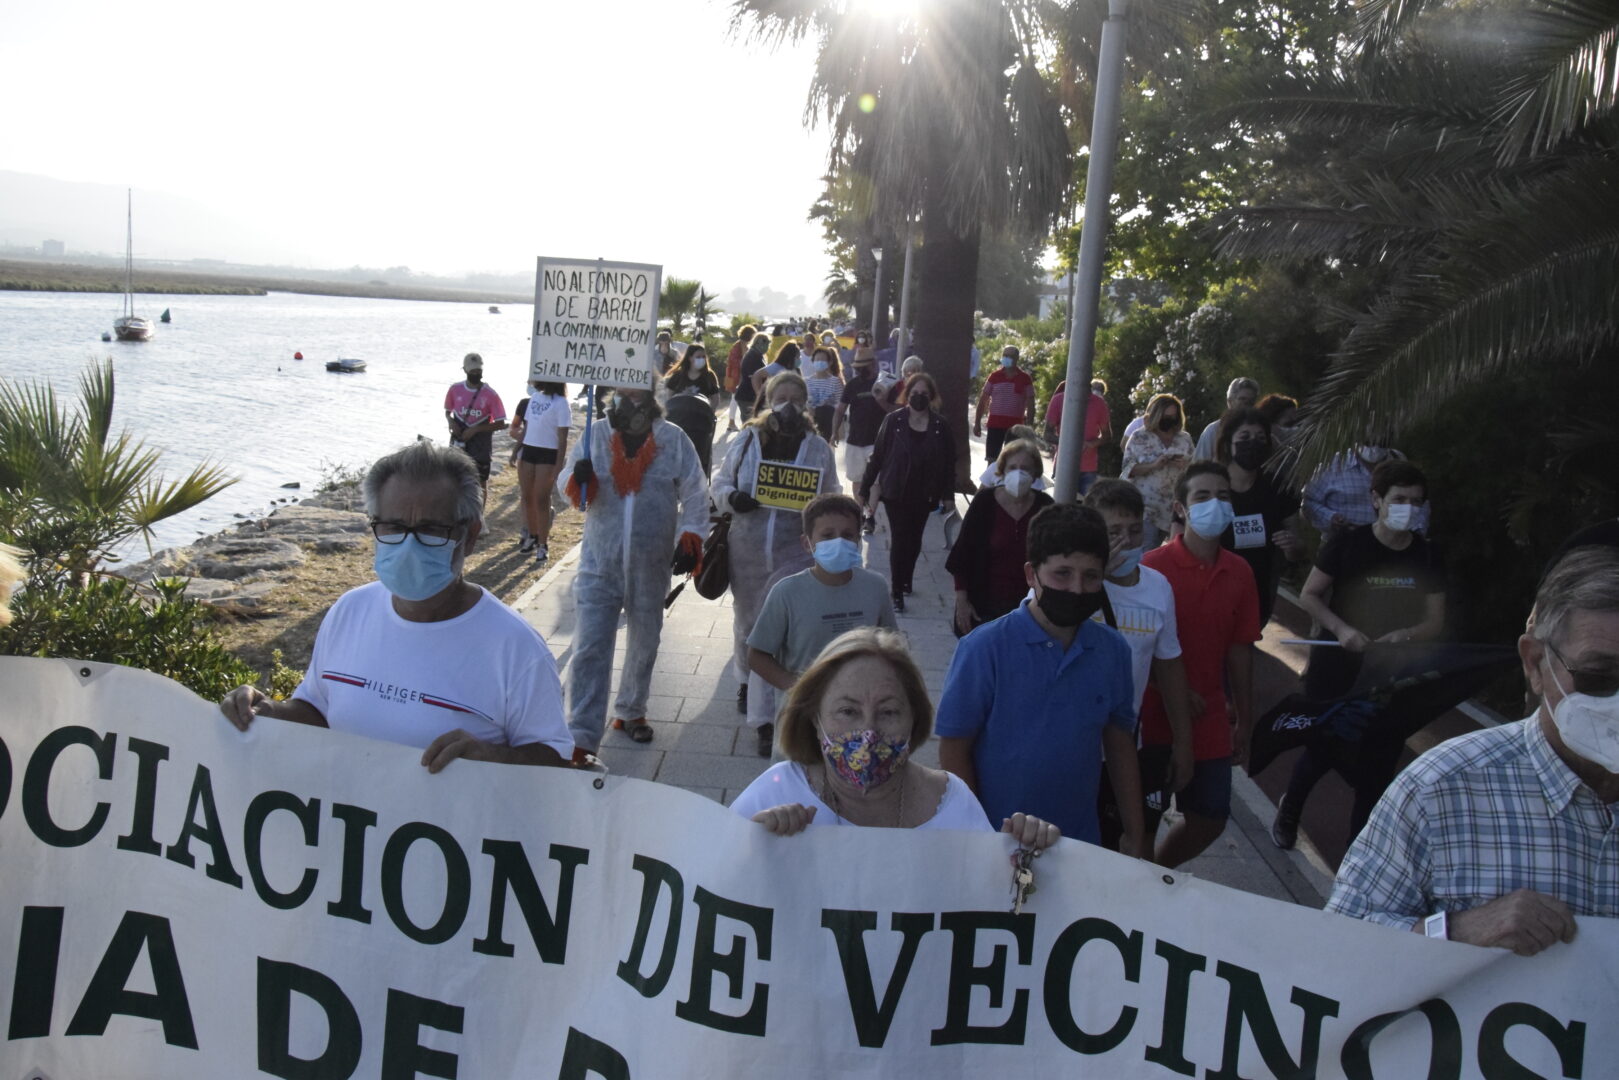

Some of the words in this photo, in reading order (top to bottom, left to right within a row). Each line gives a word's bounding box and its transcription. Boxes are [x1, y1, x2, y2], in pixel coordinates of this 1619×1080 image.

[544, 270, 566, 291] NO
[569, 270, 585, 293] AL
[588, 271, 648, 298] FONDO
[555, 295, 579, 318] DE
[536, 320, 551, 337] LA
[565, 340, 606, 362] MATA
[549, 361, 561, 376] AL
[565, 363, 611, 381] EMPLEO
[614, 367, 651, 385] VERDE
[758, 465, 775, 483] SE
[778, 468, 819, 489] VENDE
[365, 680, 425, 702] HILFIGER
[0, 725, 589, 965] CIACION
[616, 853, 775, 1038] DE
[820, 908, 1587, 1080] VECINOS
[8, 906, 199, 1050] IA
[257, 956, 465, 1080] DE
